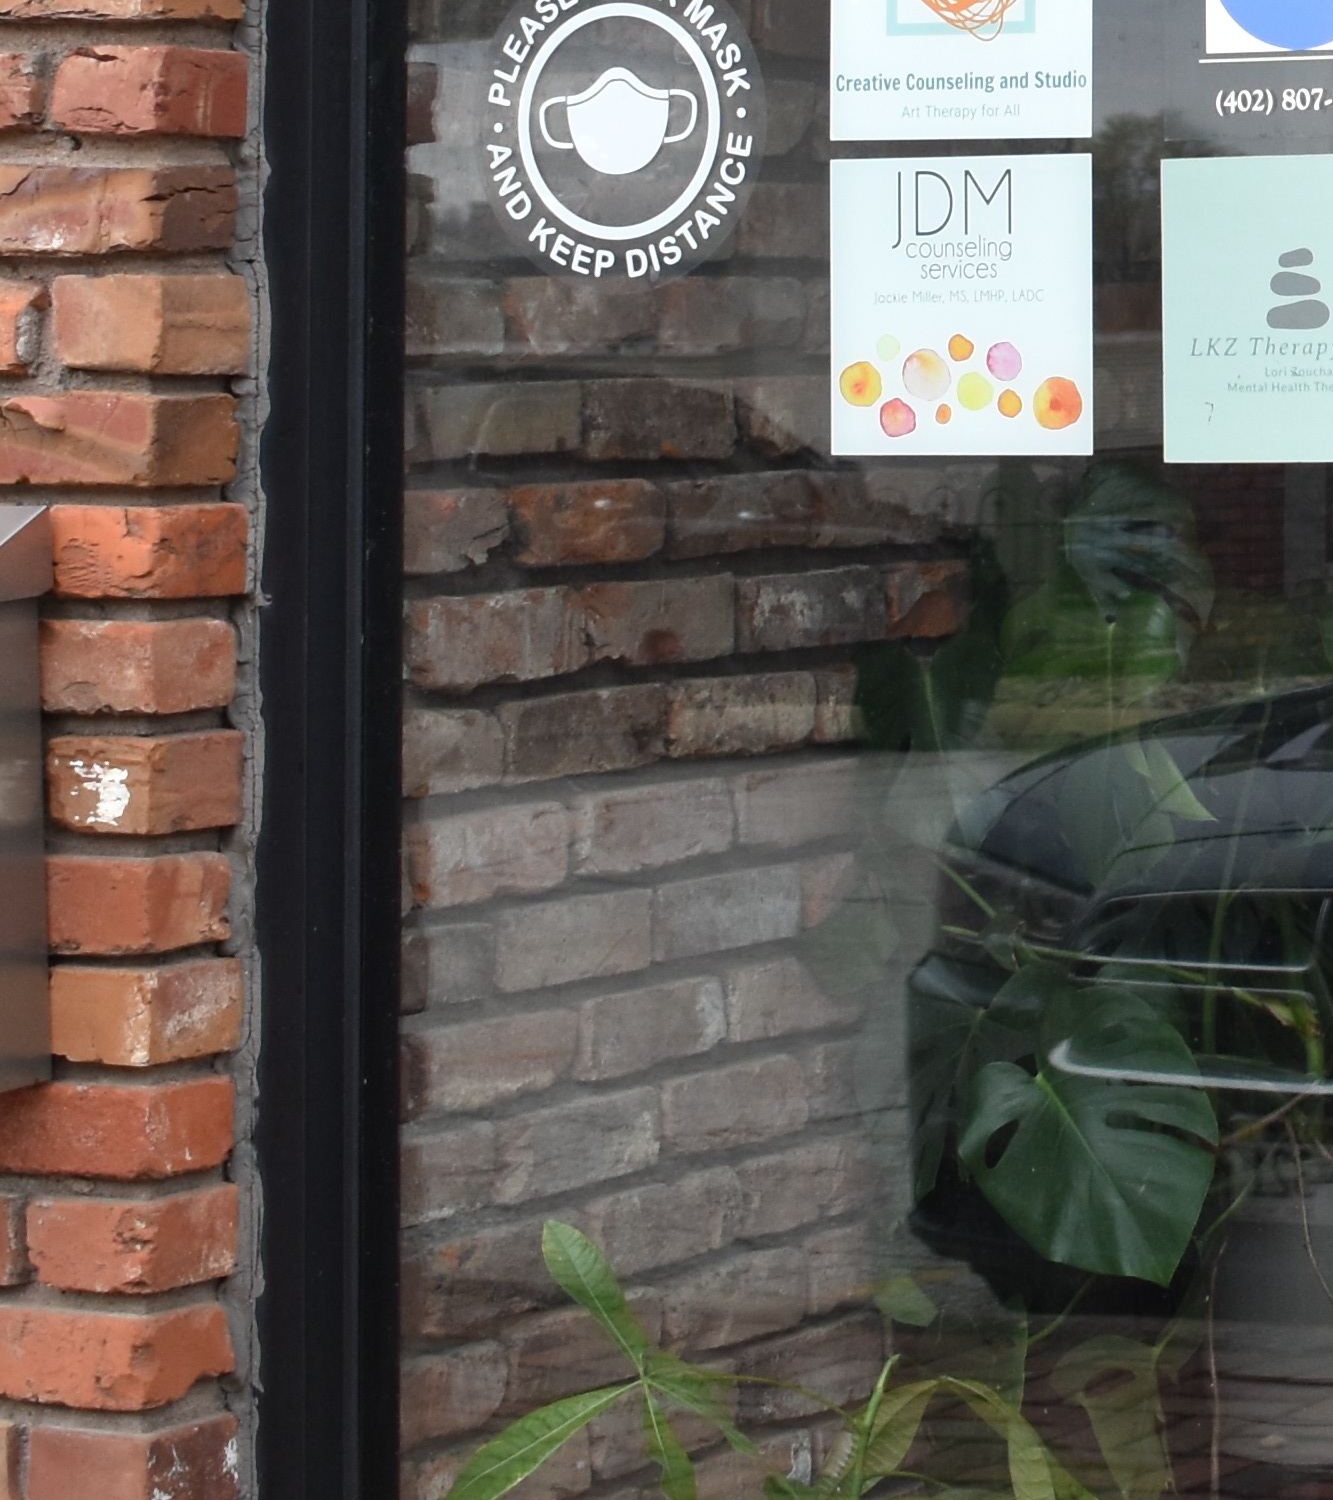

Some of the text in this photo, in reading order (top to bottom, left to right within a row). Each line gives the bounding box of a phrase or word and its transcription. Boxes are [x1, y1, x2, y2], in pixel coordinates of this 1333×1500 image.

[836, 70, 1087, 93] Creative Counseling and Studio
[902, 103, 1020, 120] Art Therapy for All
[1215, 89, 1274, 117] (402)
[487, 132, 753, 278] AND KEEP DISTANCE
[891, 168, 1013, 250] JDM
[905, 235, 1013, 261] counseling
[920, 259, 998, 280] services
[874, 290, 908, 305] Jackie
[1012, 288, 1044, 303] LADC
[1190, 337, 1239, 357] LKZ
[1264, 366, 1288, 377] Lori
[1227, 381, 1268, 393] Mental
[1271, 381, 1311, 393] Health
